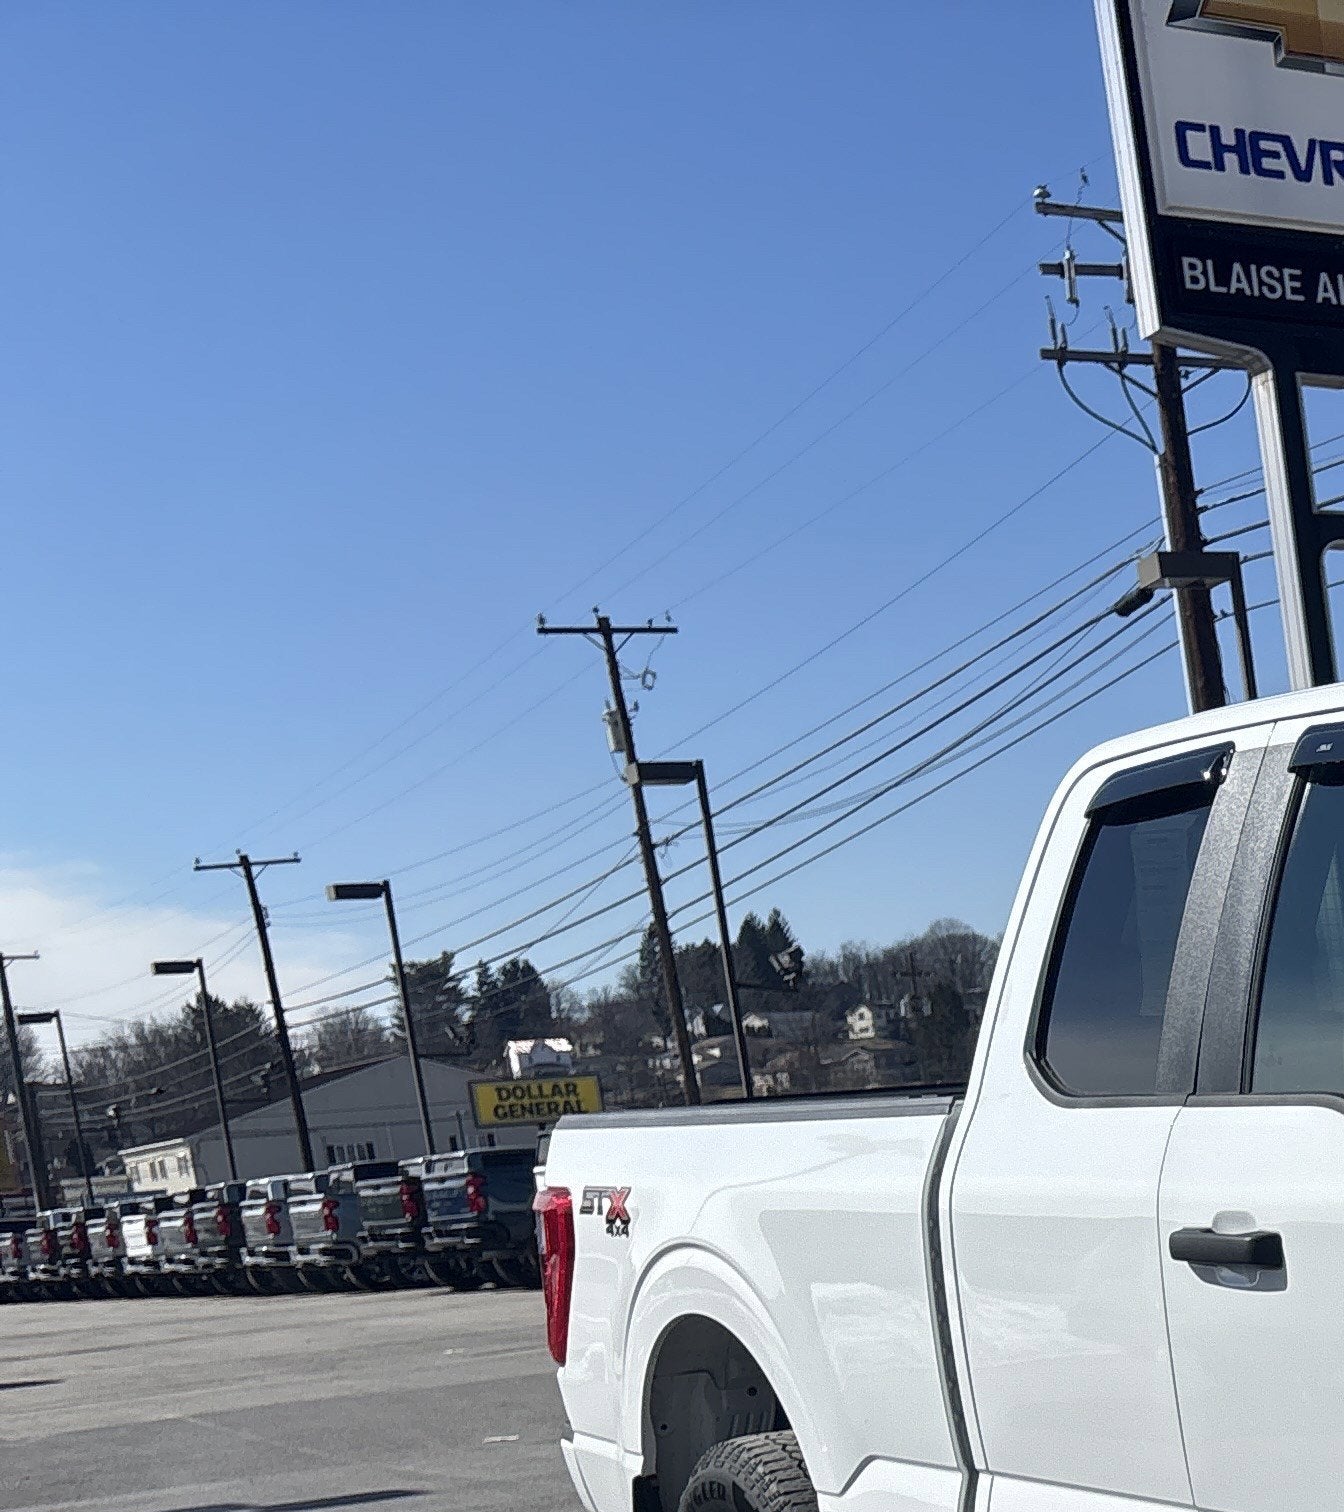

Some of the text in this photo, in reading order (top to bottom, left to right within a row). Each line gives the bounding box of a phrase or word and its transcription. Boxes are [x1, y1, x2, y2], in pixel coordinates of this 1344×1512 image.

[1181, 256, 1306, 302] BLAISE
[495, 1081, 579, 1101] DOLLAR
[493, 1099, 589, 1120] GENERAL
[579, 1186, 632, 1224] STX
